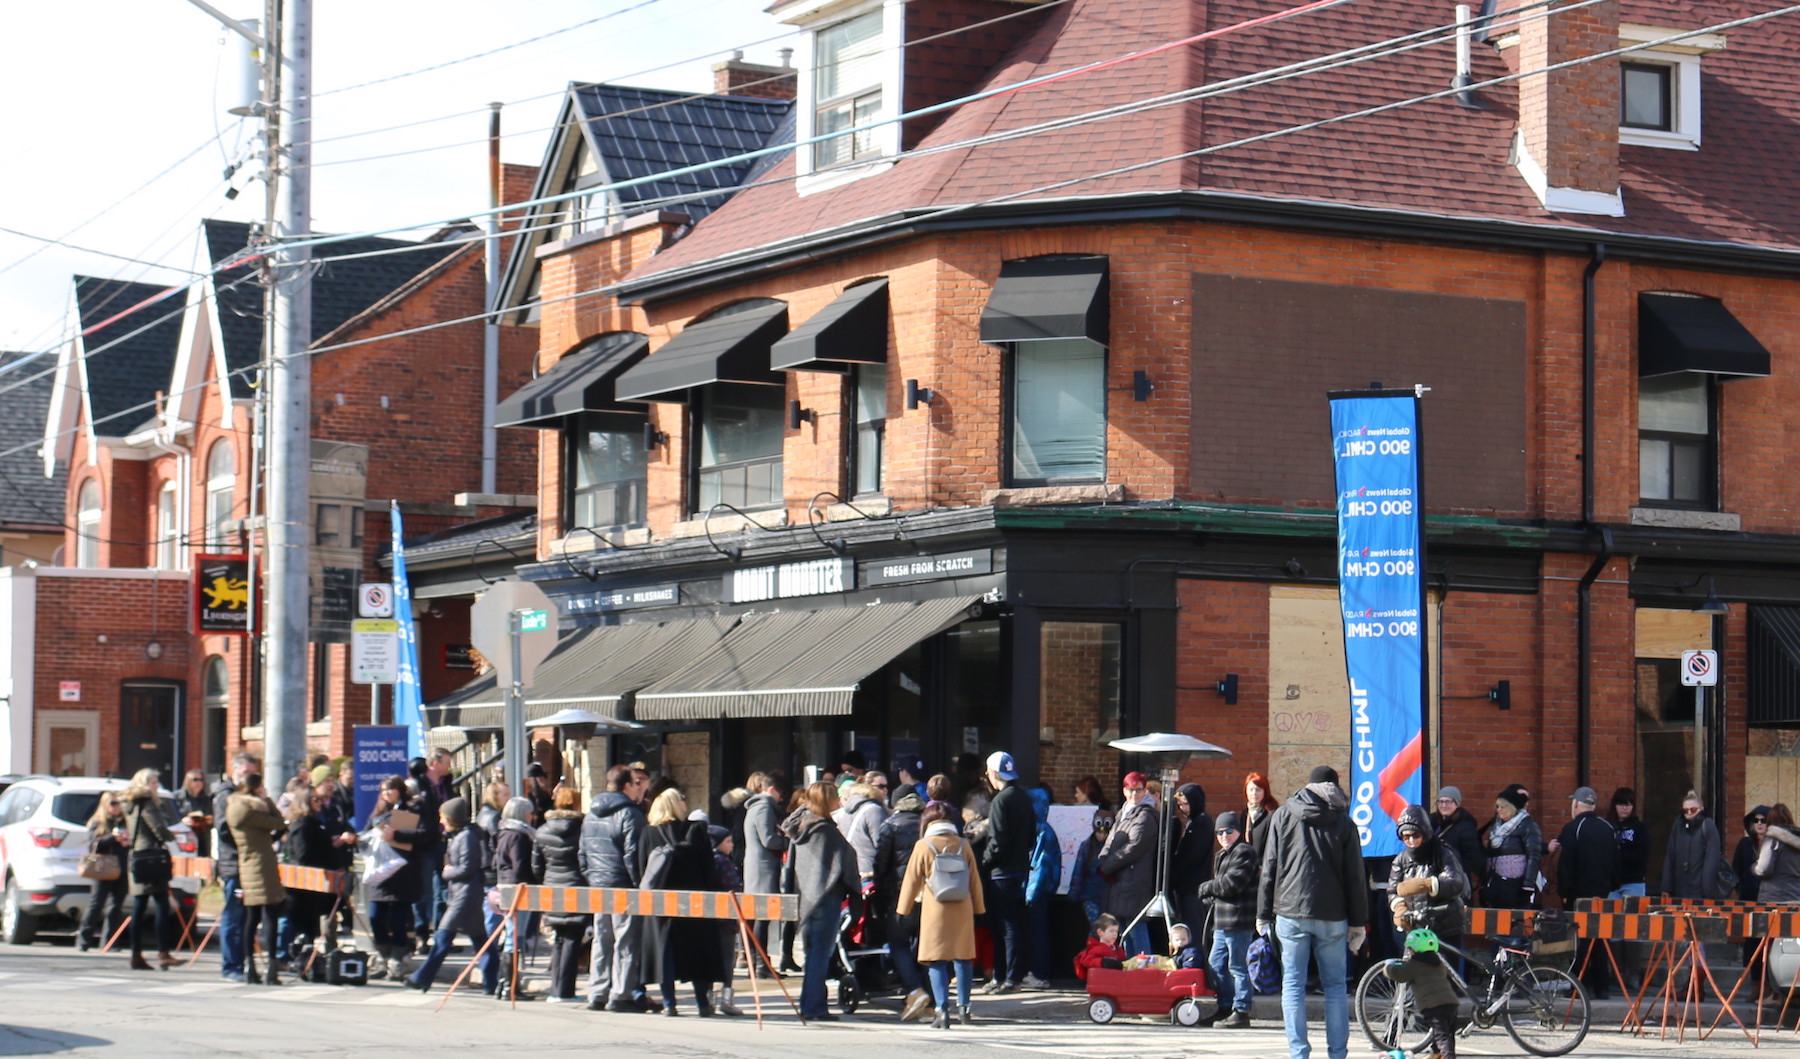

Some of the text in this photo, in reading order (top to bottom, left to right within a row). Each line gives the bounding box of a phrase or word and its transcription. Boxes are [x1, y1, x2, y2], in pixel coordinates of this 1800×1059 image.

[883, 557, 973, 578] FRESH FROM SCRATCH
[633, 589, 673, 603] MILKSHAKES
[359, 750, 407, 762] 900 CHML
